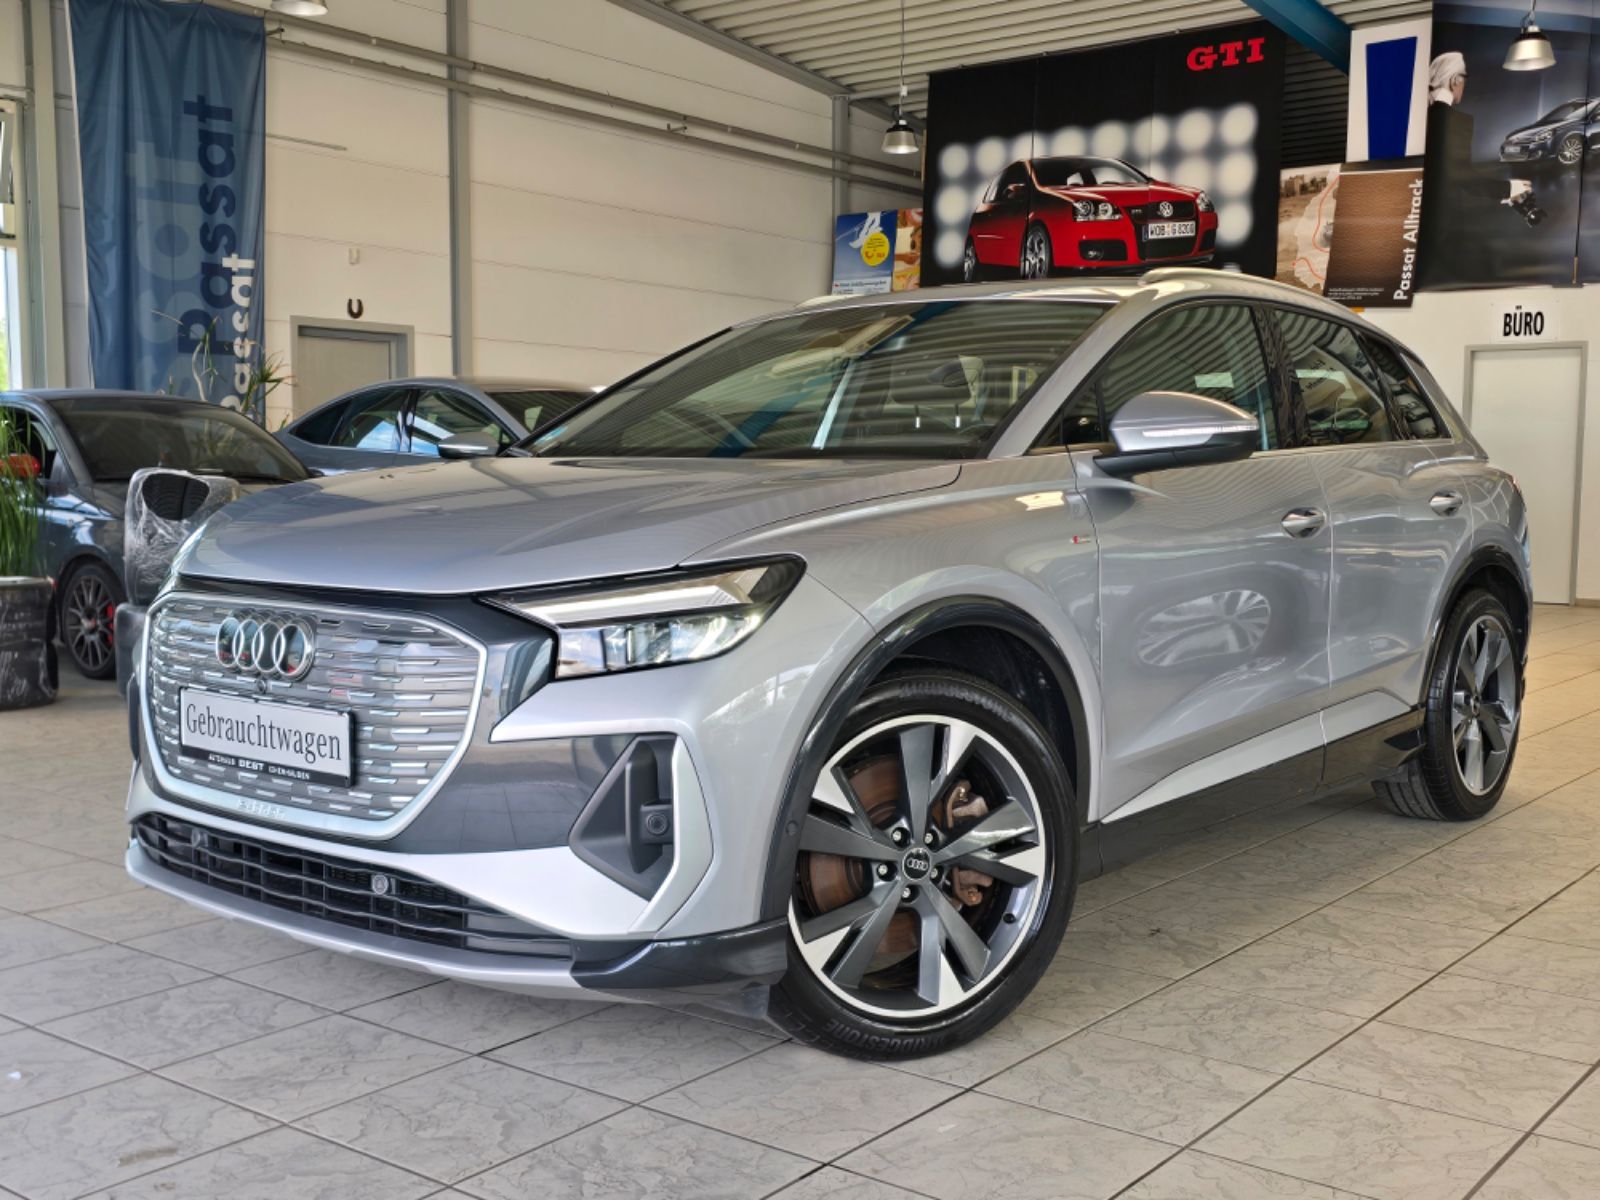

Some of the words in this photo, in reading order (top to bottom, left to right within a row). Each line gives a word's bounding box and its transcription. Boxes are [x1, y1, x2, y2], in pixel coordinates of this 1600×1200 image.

[1186, 37, 1266, 72] GTI
[176, 94, 237, 356] Passat
[1403, 179, 1424, 242] Alltrack
[1393, 247, 1416, 300] Passat
[1502, 305, 1545, 337] BÜRO
[185, 703, 342, 765] Gebrauchtwagen
